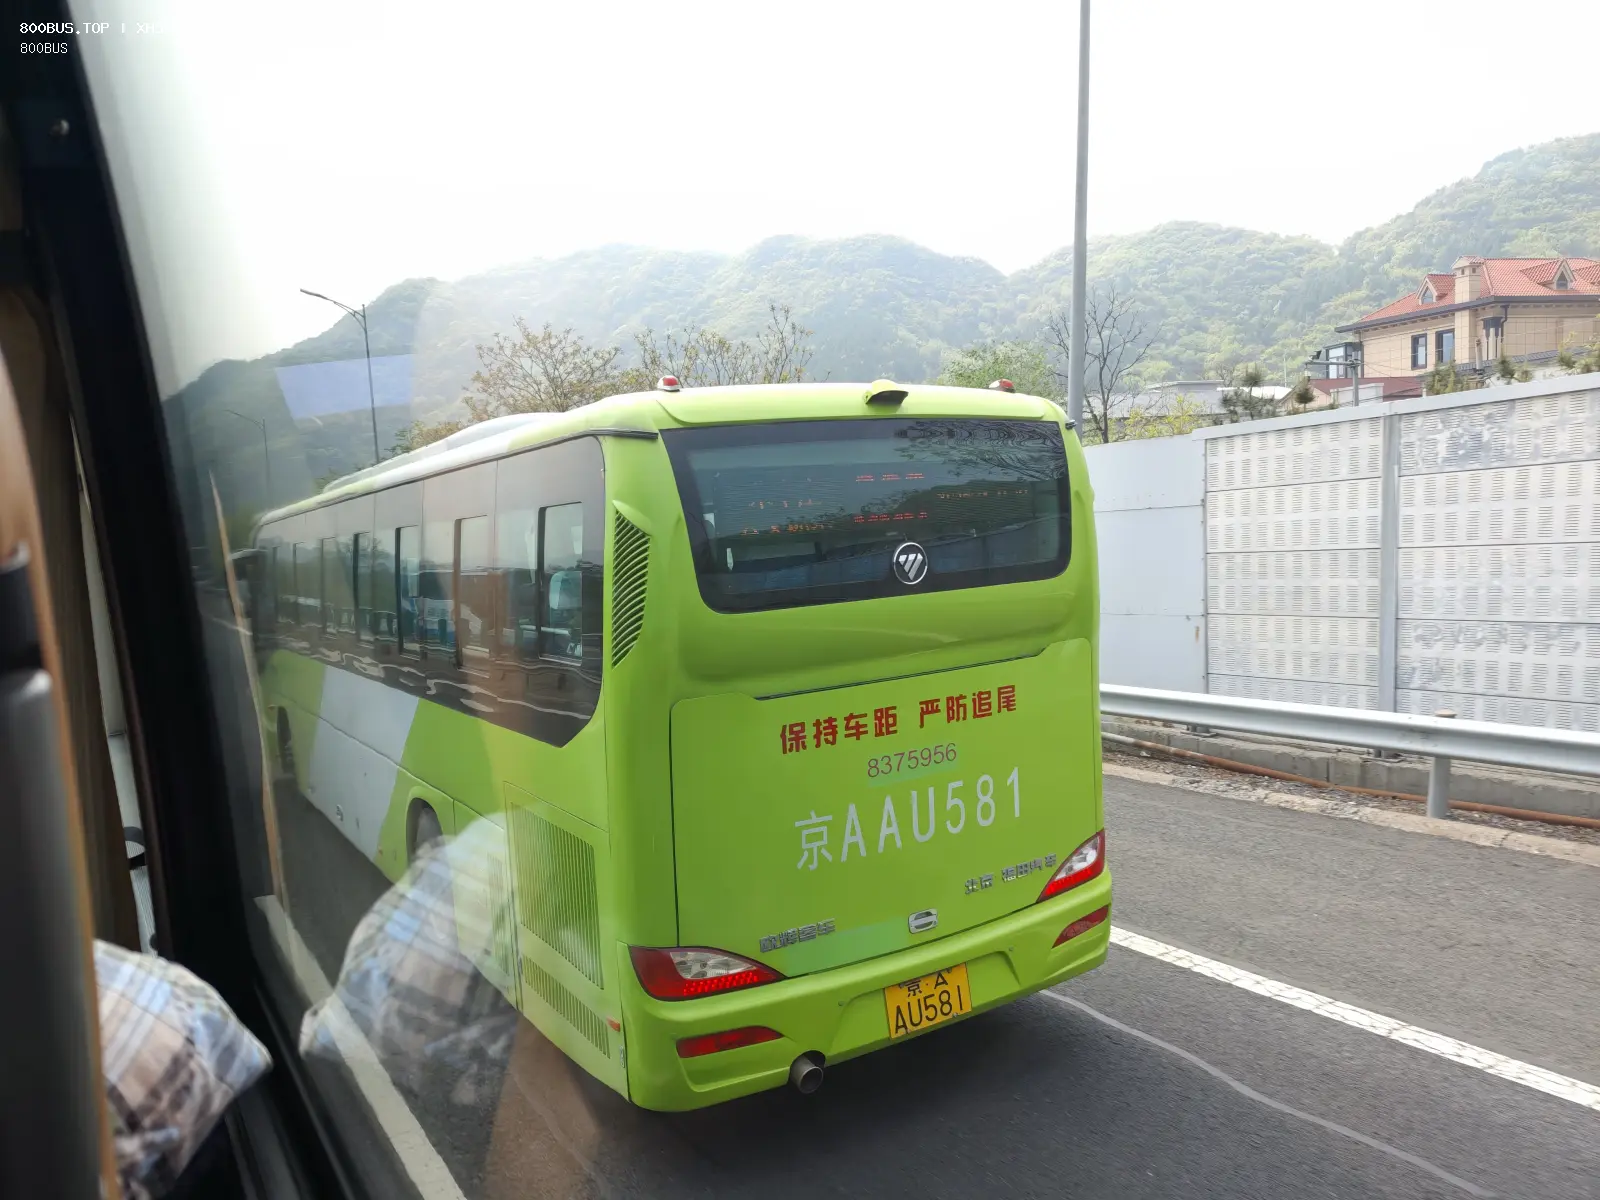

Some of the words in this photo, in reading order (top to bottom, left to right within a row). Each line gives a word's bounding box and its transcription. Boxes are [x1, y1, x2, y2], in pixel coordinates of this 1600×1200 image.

[780, 705, 898, 755] 保持车距
[919, 684, 1017, 729] 严防追尾
[867, 742, 957, 778] 8375956
[794, 766, 1021, 871] 京AAU581
[965, 873, 994, 895] 北京
[1001, 853, 1057, 883] 福田汽车
[894, 984, 964, 1035] AU581
